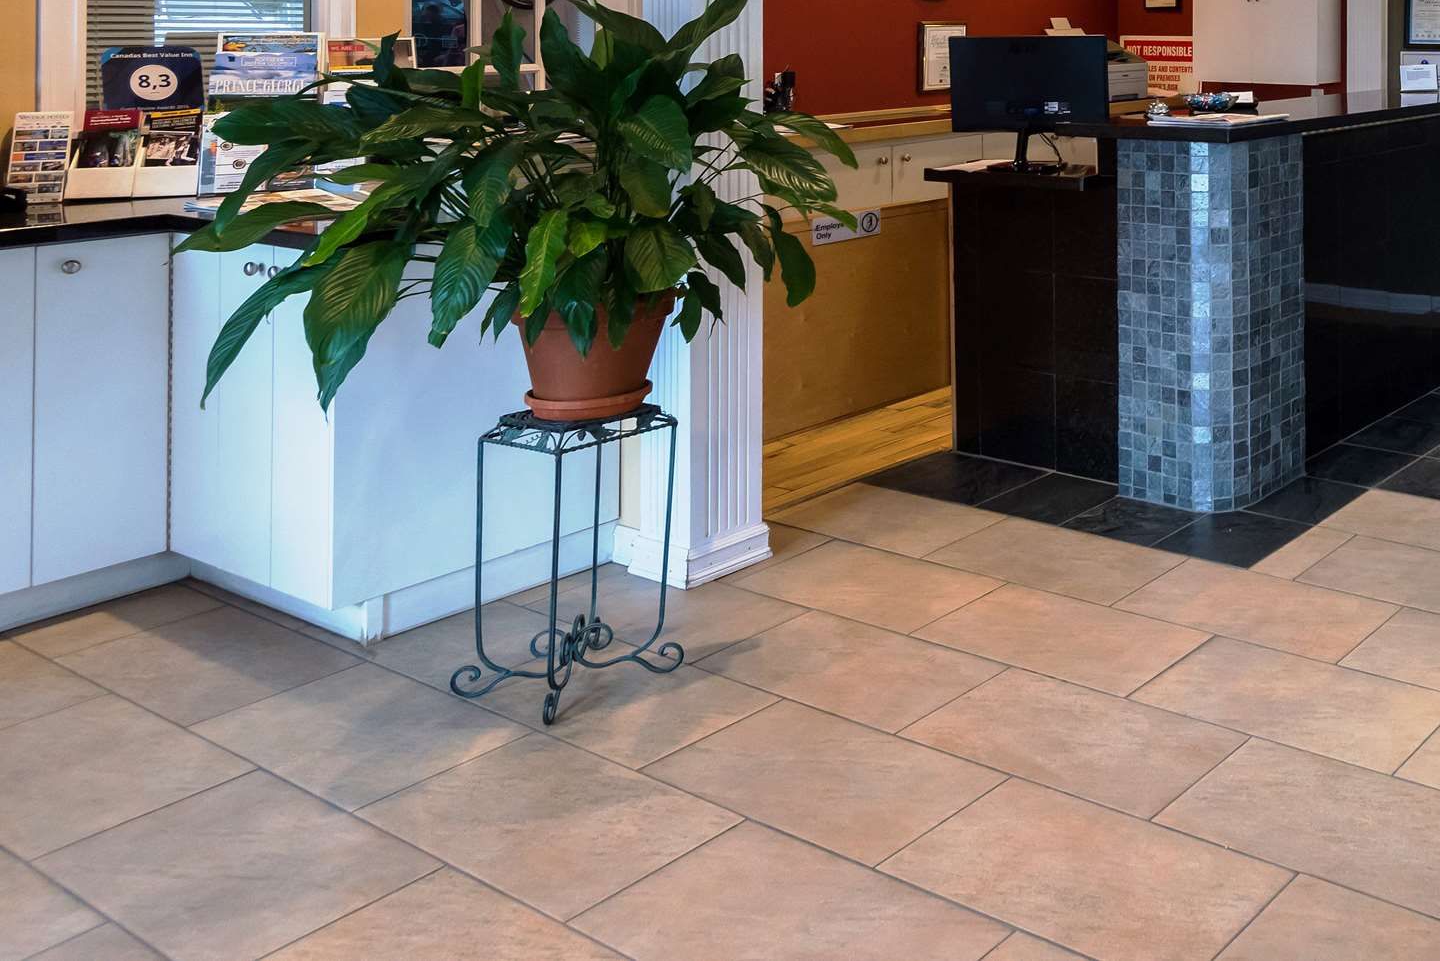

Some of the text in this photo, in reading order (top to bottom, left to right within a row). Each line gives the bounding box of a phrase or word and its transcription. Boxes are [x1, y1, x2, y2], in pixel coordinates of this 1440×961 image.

[1143, 45, 1192, 57] RESPONSIBLE
[138, 74, 171, 90] 8,3
[216, 79, 257, 93] PRINCE
[816, 232, 832, 240] Only
